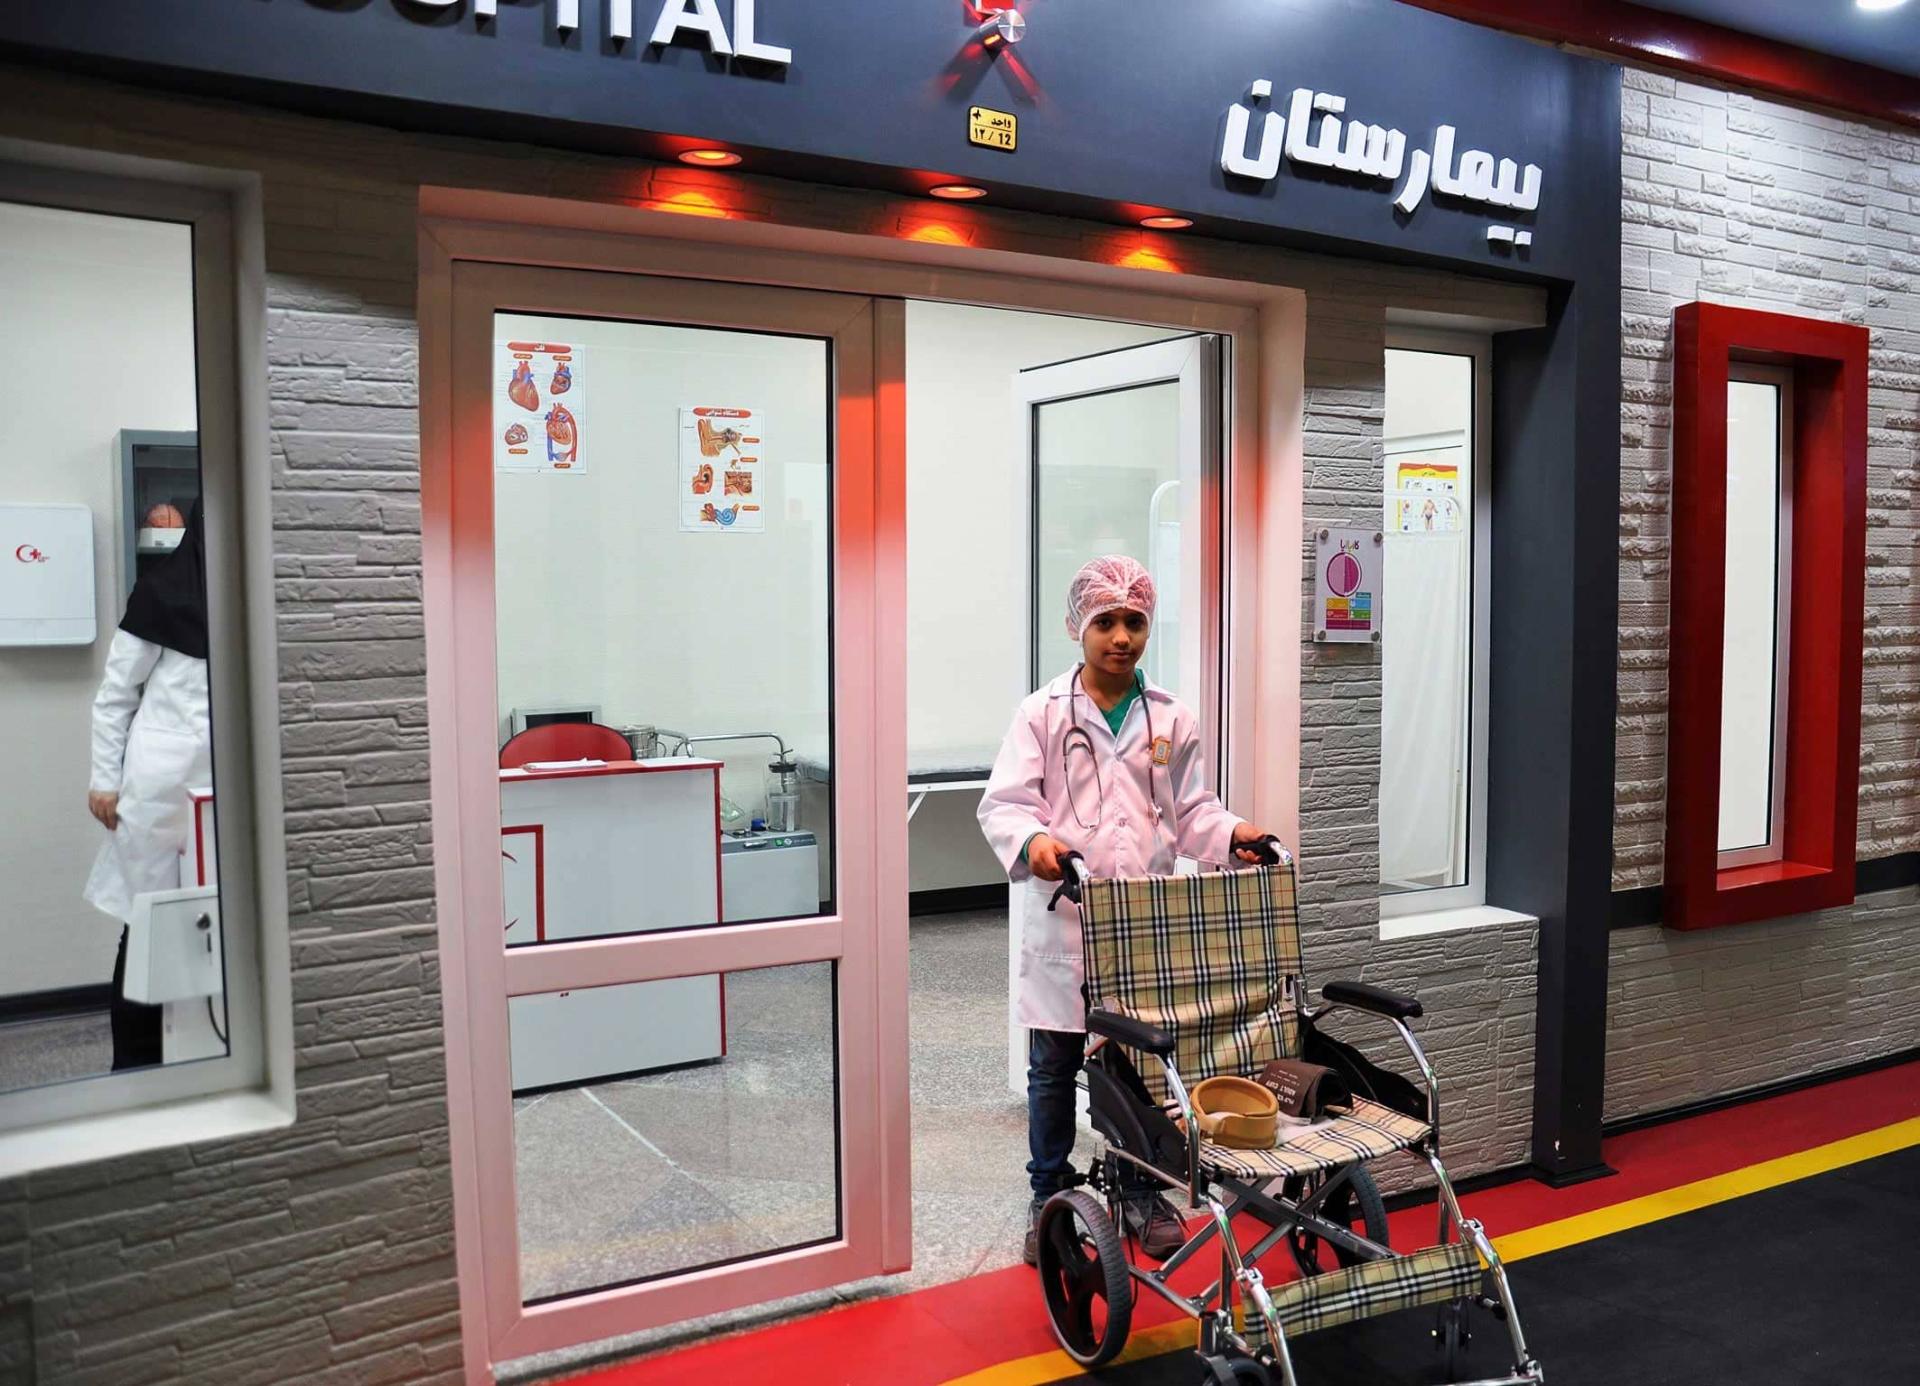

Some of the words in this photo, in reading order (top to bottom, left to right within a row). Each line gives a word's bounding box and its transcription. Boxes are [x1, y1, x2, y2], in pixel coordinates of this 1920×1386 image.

[991, 118, 1011, 128] واحد
[998, 132, 1011, 146] 12
[1221, 78, 1543, 246] بیمارستان
